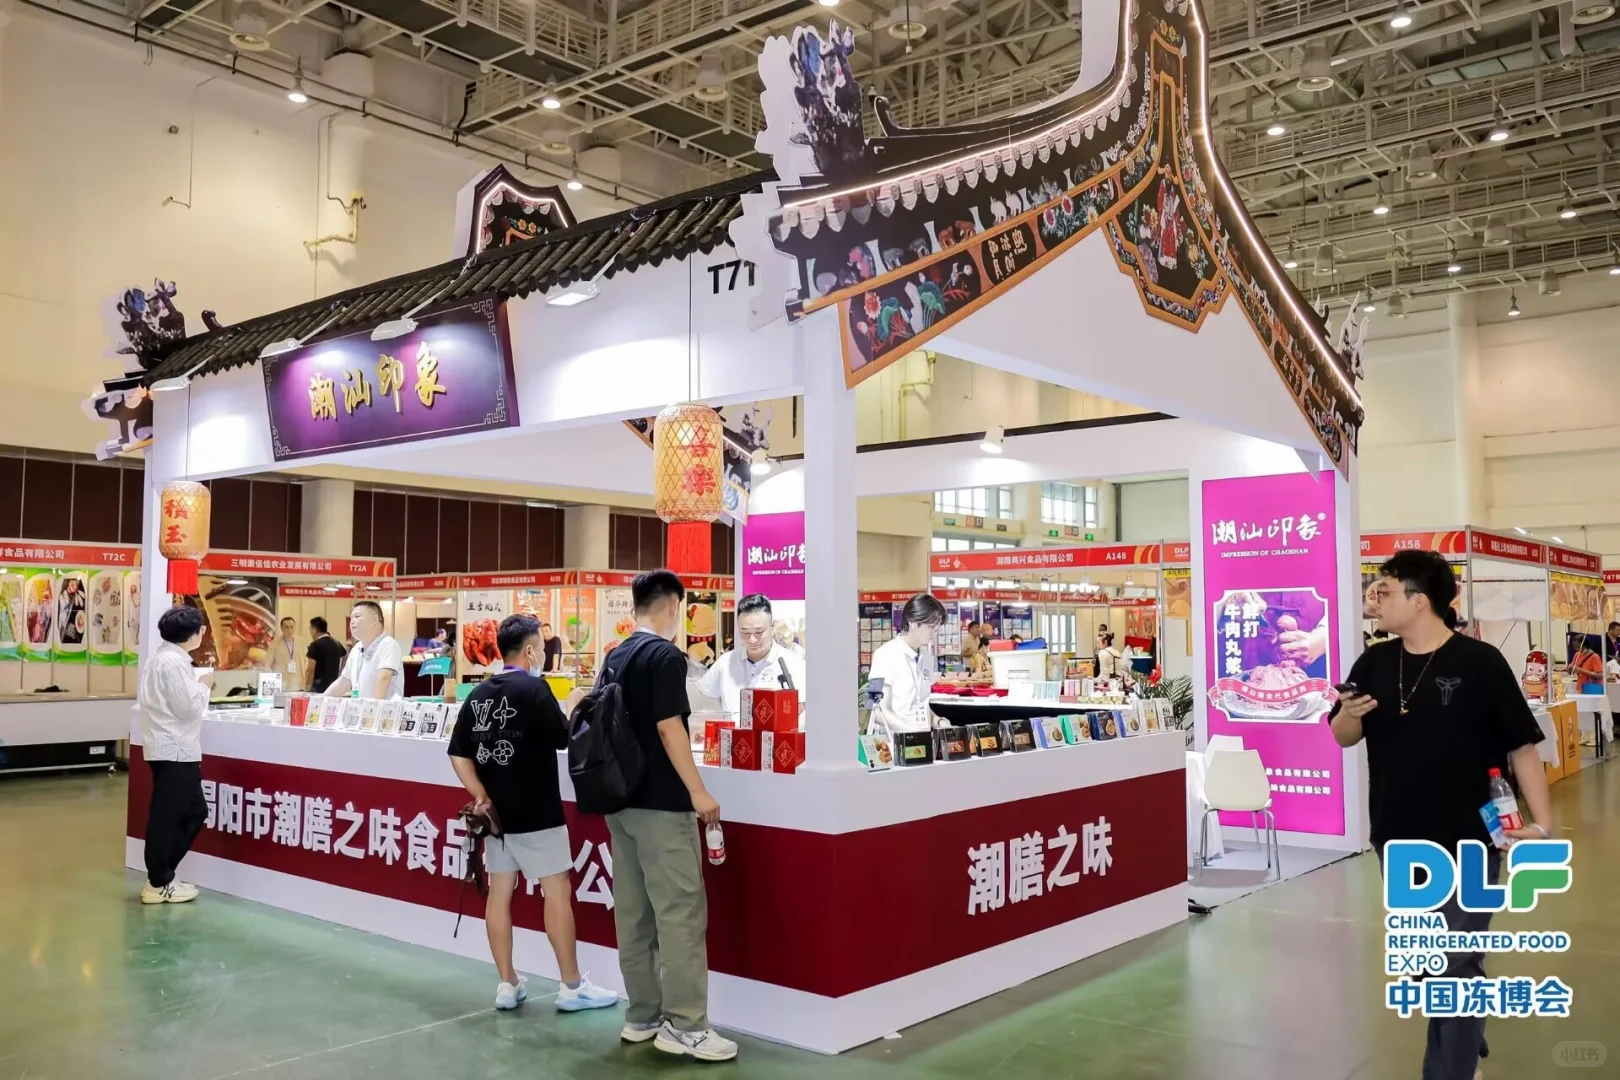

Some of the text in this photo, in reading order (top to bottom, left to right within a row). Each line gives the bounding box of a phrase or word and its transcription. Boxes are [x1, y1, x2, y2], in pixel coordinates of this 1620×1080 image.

[707, 259, 756, 295] T71
[308, 341, 447, 420] 潮汕印象
[1212, 514, 1322, 546] 潮汕印象
[1393, 540, 1421, 549] A158
[102, 552, 126, 561] T72C
[1106, 552, 1127, 560] A148
[1221, 550, 1259, 558] IMPRESSION
[1271, 548, 1309, 556] CHAOSHAN
[349, 564, 367, 573] T72A
[967, 815, 1113, 916] 潮膳之味
